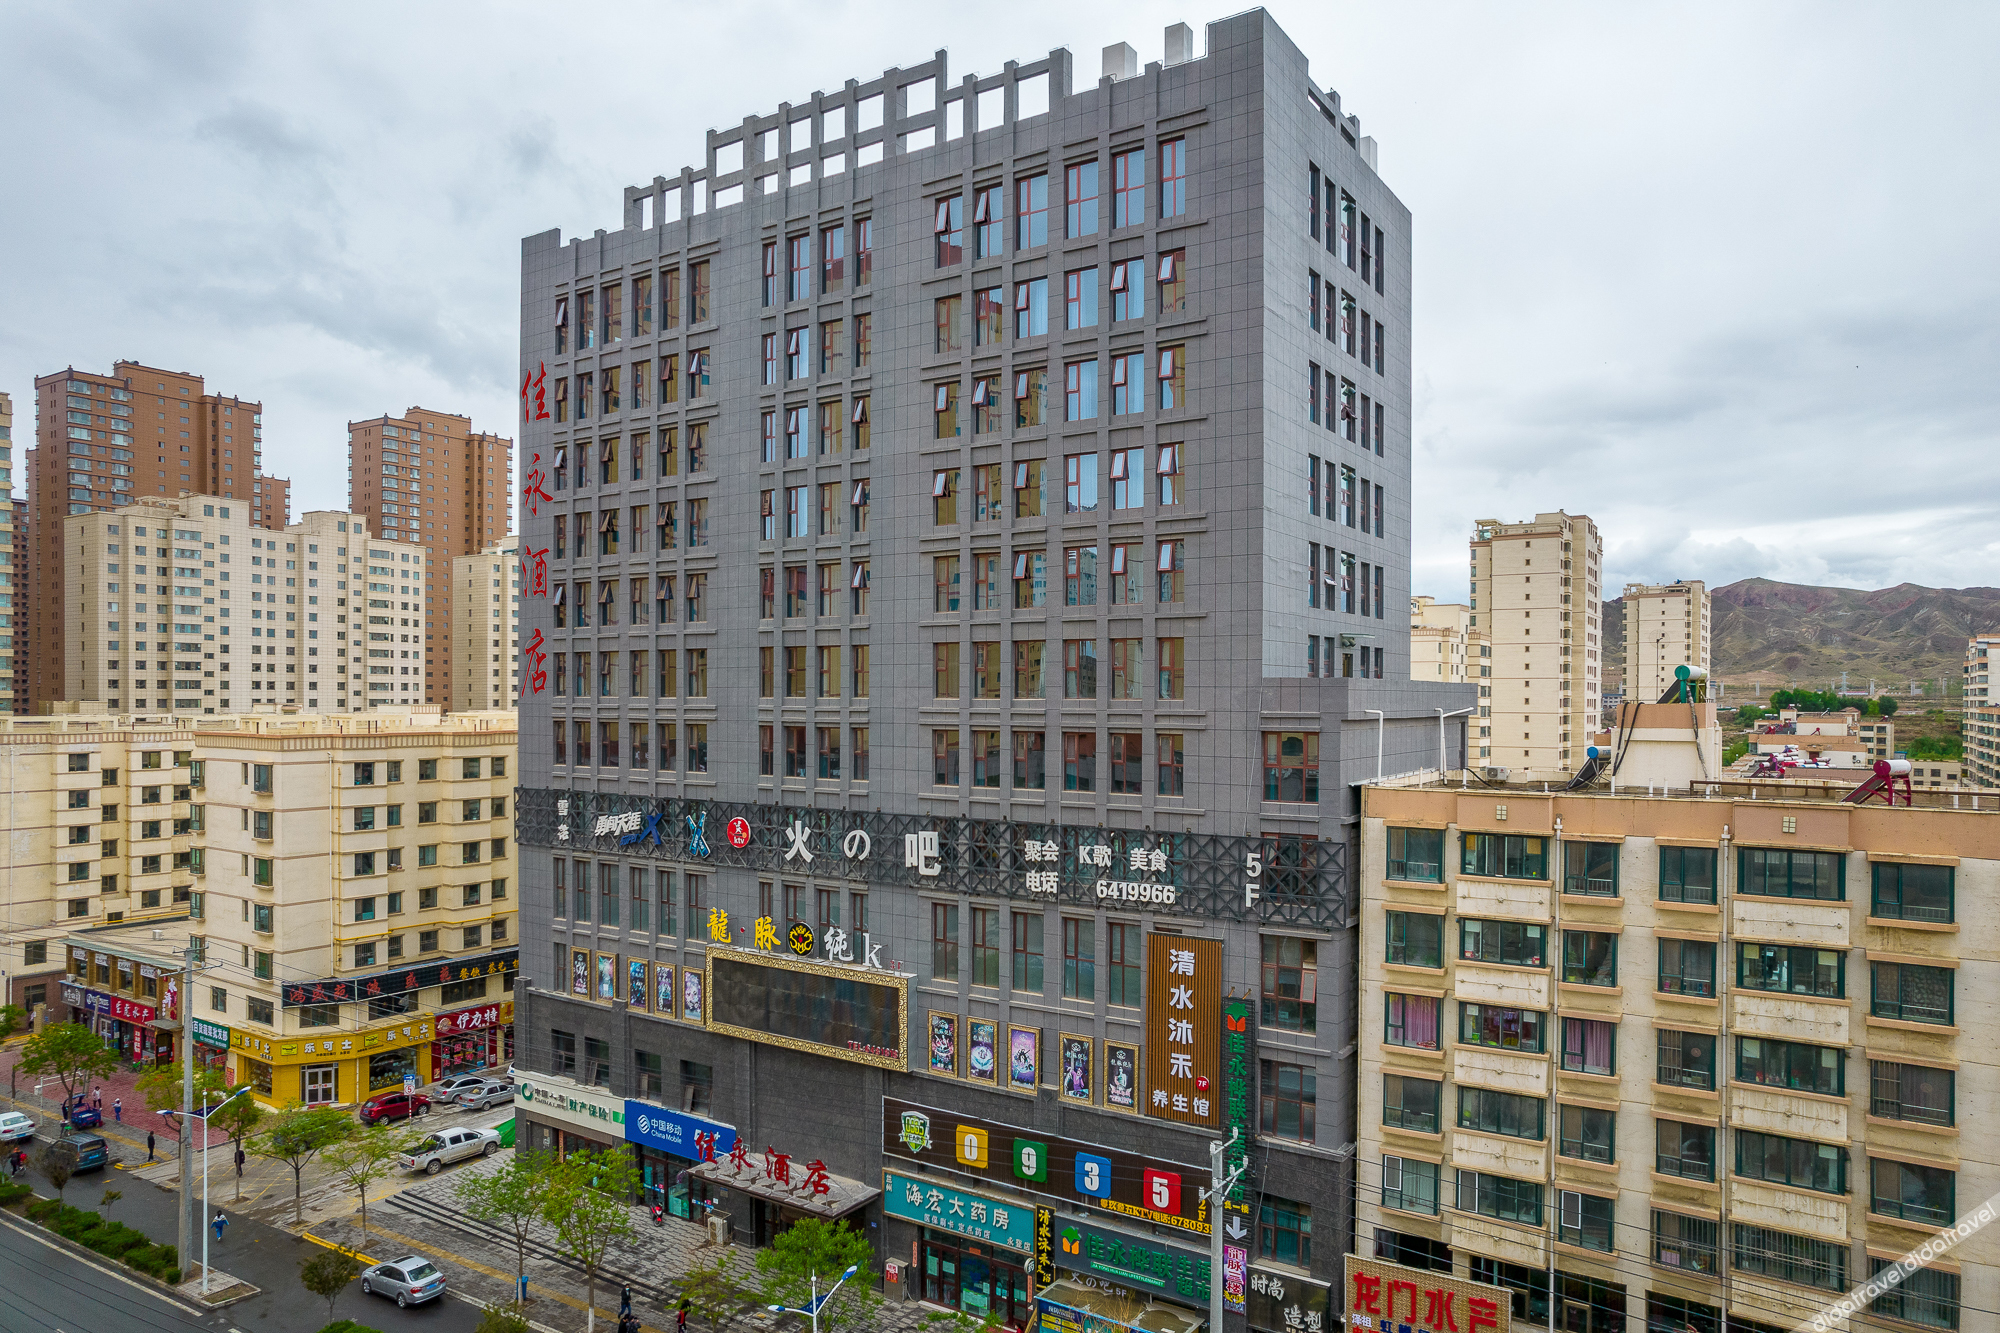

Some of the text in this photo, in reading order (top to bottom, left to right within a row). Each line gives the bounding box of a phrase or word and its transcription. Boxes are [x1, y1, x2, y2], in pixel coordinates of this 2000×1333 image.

[521, 359, 554, 698] 佳永酒店
[594, 811, 642, 837] 勇闯天涯
[785, 820, 942, 876] 火の吧
[1024, 840, 1168, 873] 聚会 K歌 美食
[1025, 871, 1175, 904] 电话 6419966
[457, 1007, 498, 1029] 伊力特
[1168, 948, 1195, 1079] 清水沐禾
[244, 1036, 271, 1053] 乐可士
[304, 1039, 352, 1054] 乐可士
[386, 1023, 429, 1041] 乐可士
[1197, 1079, 1207, 1088] 7F
[534, 1087, 608, 1121] 中国人寿 财产保险
[1152, 1089, 1210, 1118] 养生馆
[651, 1117, 682, 1136] 中国移动
[651, 1130, 682, 1144] China Mobile
[695, 1131, 830, 1195] 佳永酒店
[906, 1182, 1010, 1230] 海宏大药房
[1006, 1237, 1031, 1251] 永登店
[1084, 1232, 1173, 1280] 佳永桦联
[1251, 1274, 1285, 1301] 时尚
[1284, 1304, 1322, 1333] 造型
